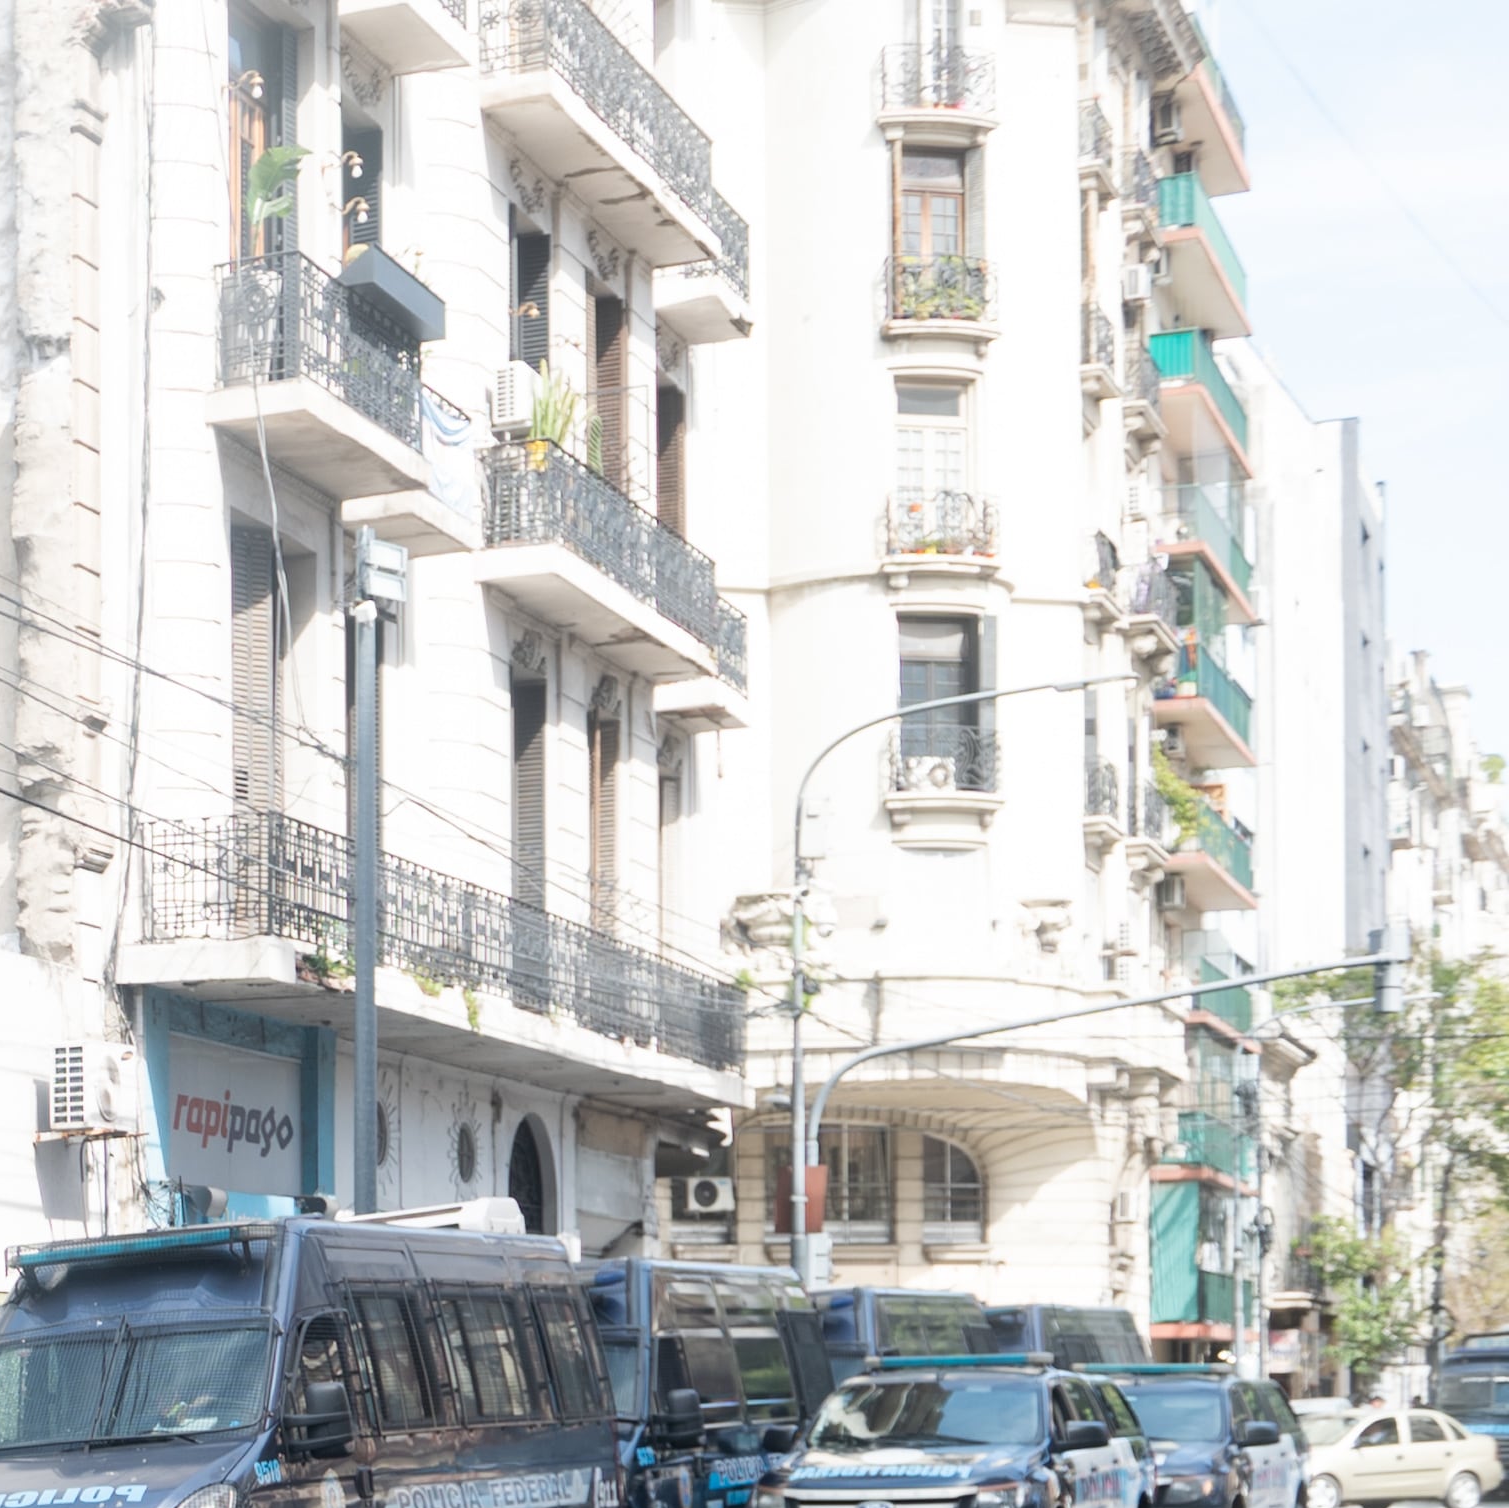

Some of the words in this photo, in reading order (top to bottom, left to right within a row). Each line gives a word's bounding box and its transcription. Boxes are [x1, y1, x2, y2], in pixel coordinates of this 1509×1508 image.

[172, 1089, 294, 1158] rapipago
[491, 1474, 573, 1508] FEDERAL
[598, 1479, 620, 1508] 911
